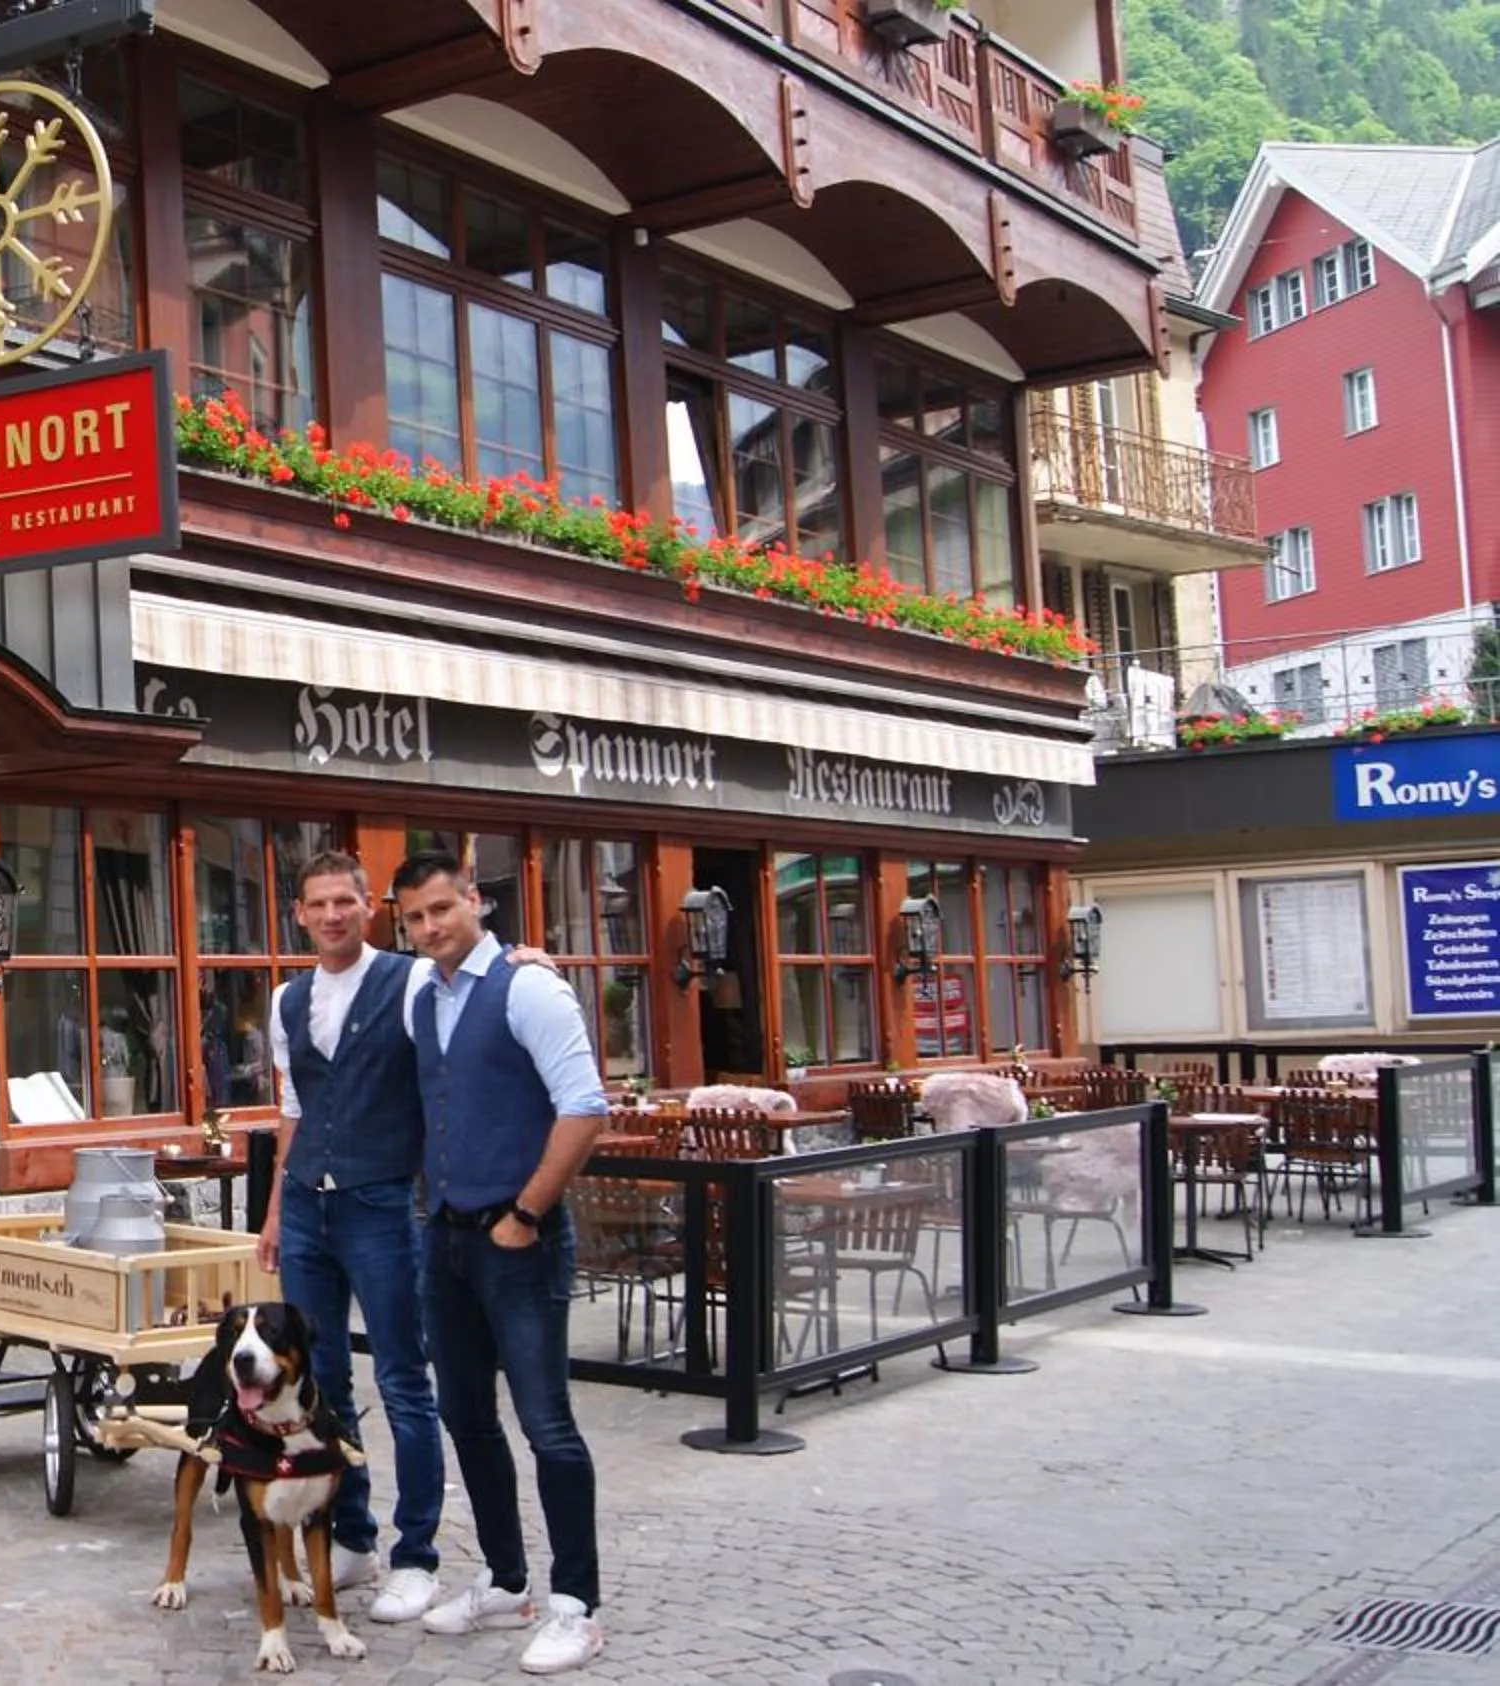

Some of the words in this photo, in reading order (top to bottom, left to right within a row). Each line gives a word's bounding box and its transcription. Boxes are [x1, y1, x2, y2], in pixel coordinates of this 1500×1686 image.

[11, 496, 135, 530] RESTAURANT
[295, 685, 433, 765] Hotel
[530, 711, 716, 795] Spannort
[787, 747, 952, 815] Restaurant
[1355, 762, 1497, 807] Romy's
